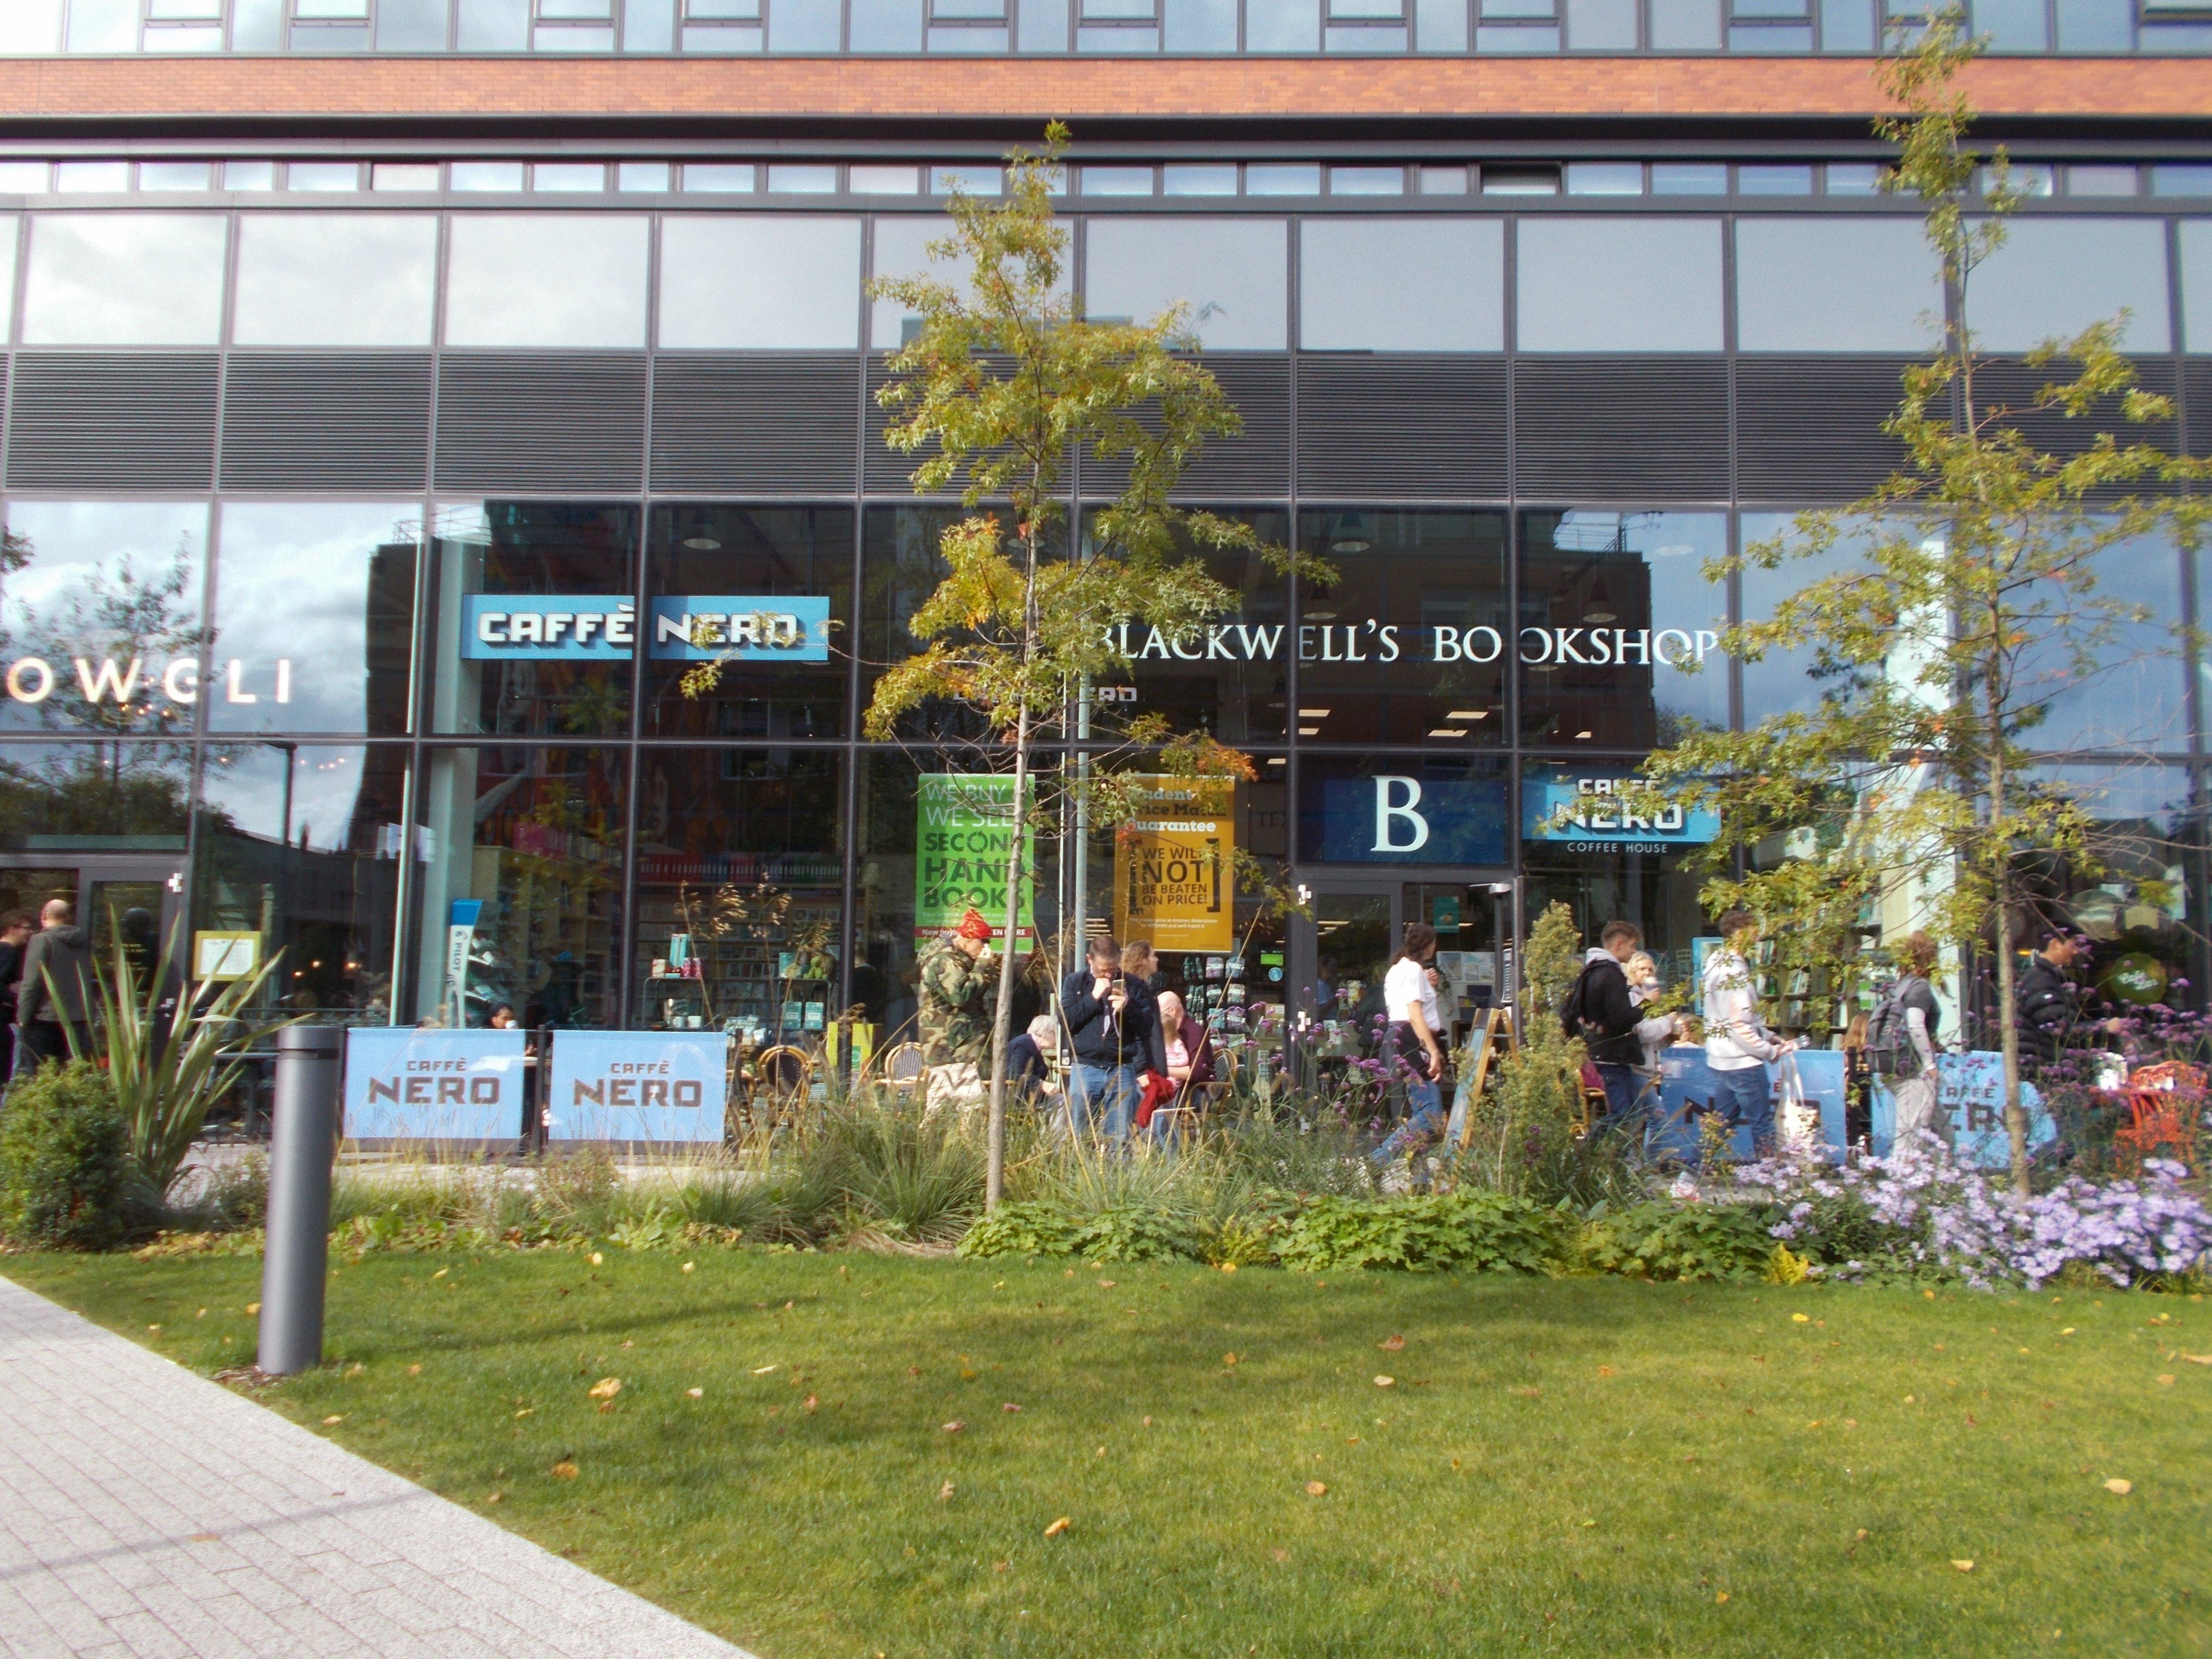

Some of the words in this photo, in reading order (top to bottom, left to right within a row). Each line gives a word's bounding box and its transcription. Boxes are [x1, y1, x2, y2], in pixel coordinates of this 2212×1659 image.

[478, 601, 635, 643] CAFFÈ
[657, 613, 800, 644] NERO
[1432, 625, 1719, 665] BOOKSHOP
[6, 657, 291, 703] OWGLI
[925, 784, 957, 801] WE
[966, 784, 1007, 801] BUY
[1142, 787, 1194, 800] udent
[926, 806, 964, 827] WE
[971, 806, 1027, 827] SEL
[1369, 776, 1429, 852] B
[1142, 848, 1165, 860] WE
[1567, 842, 1618, 853] COFFEE
[1626, 842, 1668, 853] HOUSE
[1142, 860, 1205, 883] NOT
[1142, 884, 1157, 894] BE
[1161, 883, 1207, 894] BEATEN
[1142, 895, 1163, 905] ON
[1167, 894, 1207, 905] PRICE!
[940, 928, 958, 936] buyi
[453, 942, 463, 972] PILOT
[407, 1057, 467, 1071] CAFFÈ
[611, 1060, 670, 1074] CAFFÈ
[369, 1076, 501, 1105] NERO
[573, 1078, 702, 1108] NERO
